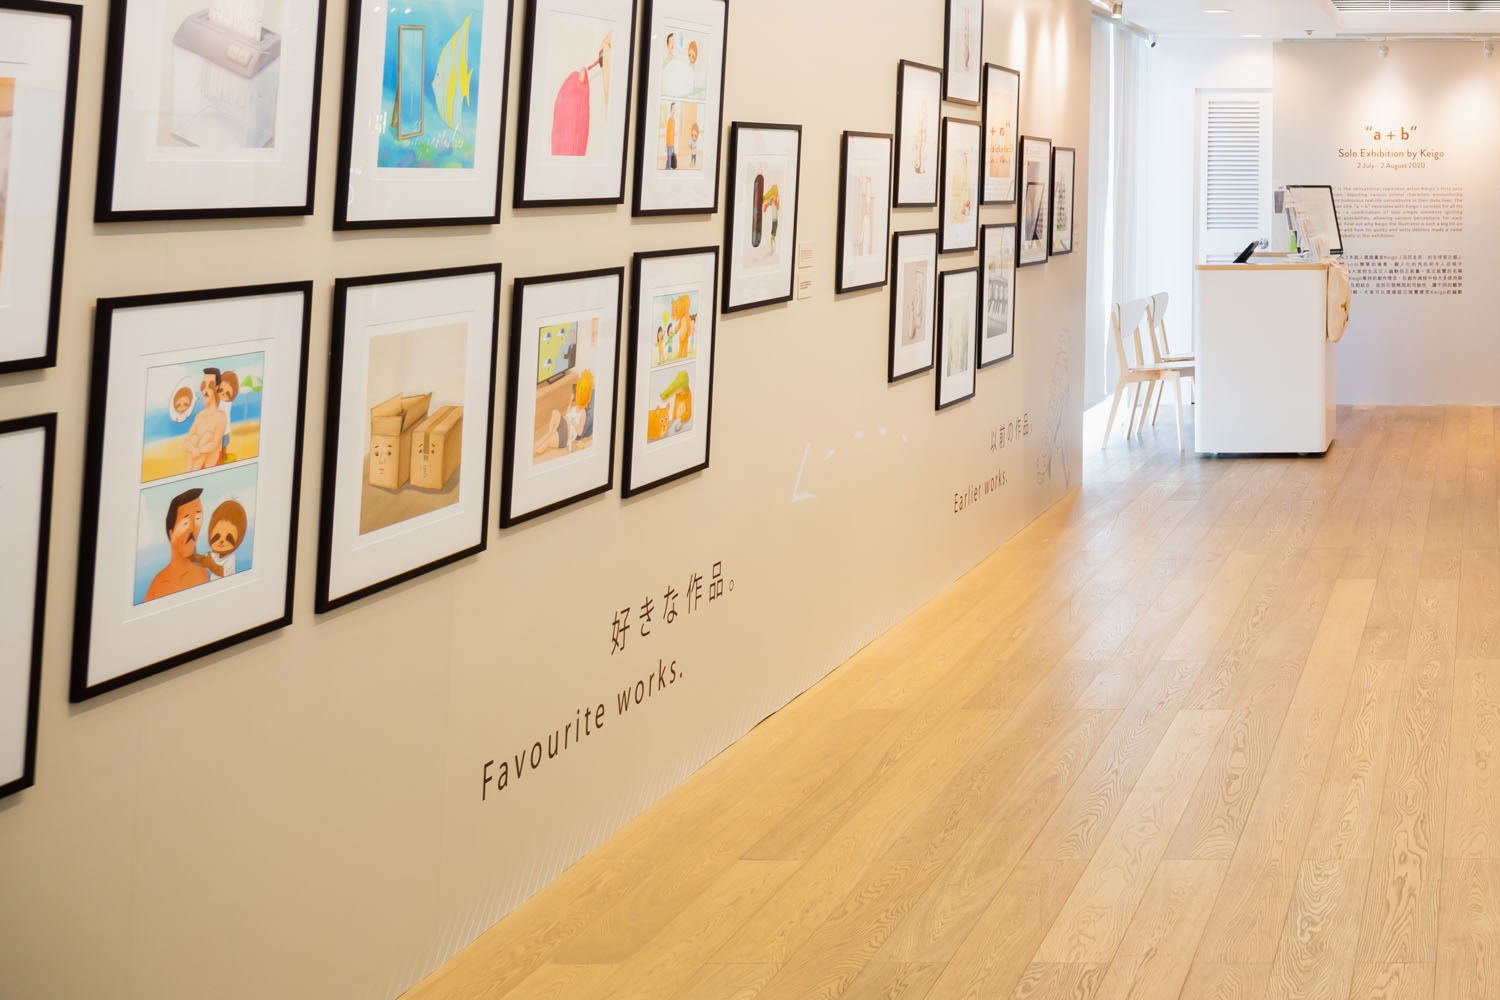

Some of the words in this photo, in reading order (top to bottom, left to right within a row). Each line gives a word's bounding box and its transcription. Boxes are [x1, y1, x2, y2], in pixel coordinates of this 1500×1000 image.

[1338, 148, 1357, 157] Solo
[1359, 148, 1404, 157] Exhibition
[1407, 148, 1417, 160] by
[1420, 148, 1444, 160] Keigo
[1363, 162, 1374, 171] July
[1386, 162, 1407, 170] August
[954, 484, 981, 513] Earlier
[984, 467, 1007, 495] works.
[610, 560, 733, 655] 好きな作品。
[481, 703, 604, 801] Favourite
[617, 658, 682, 715] works.
